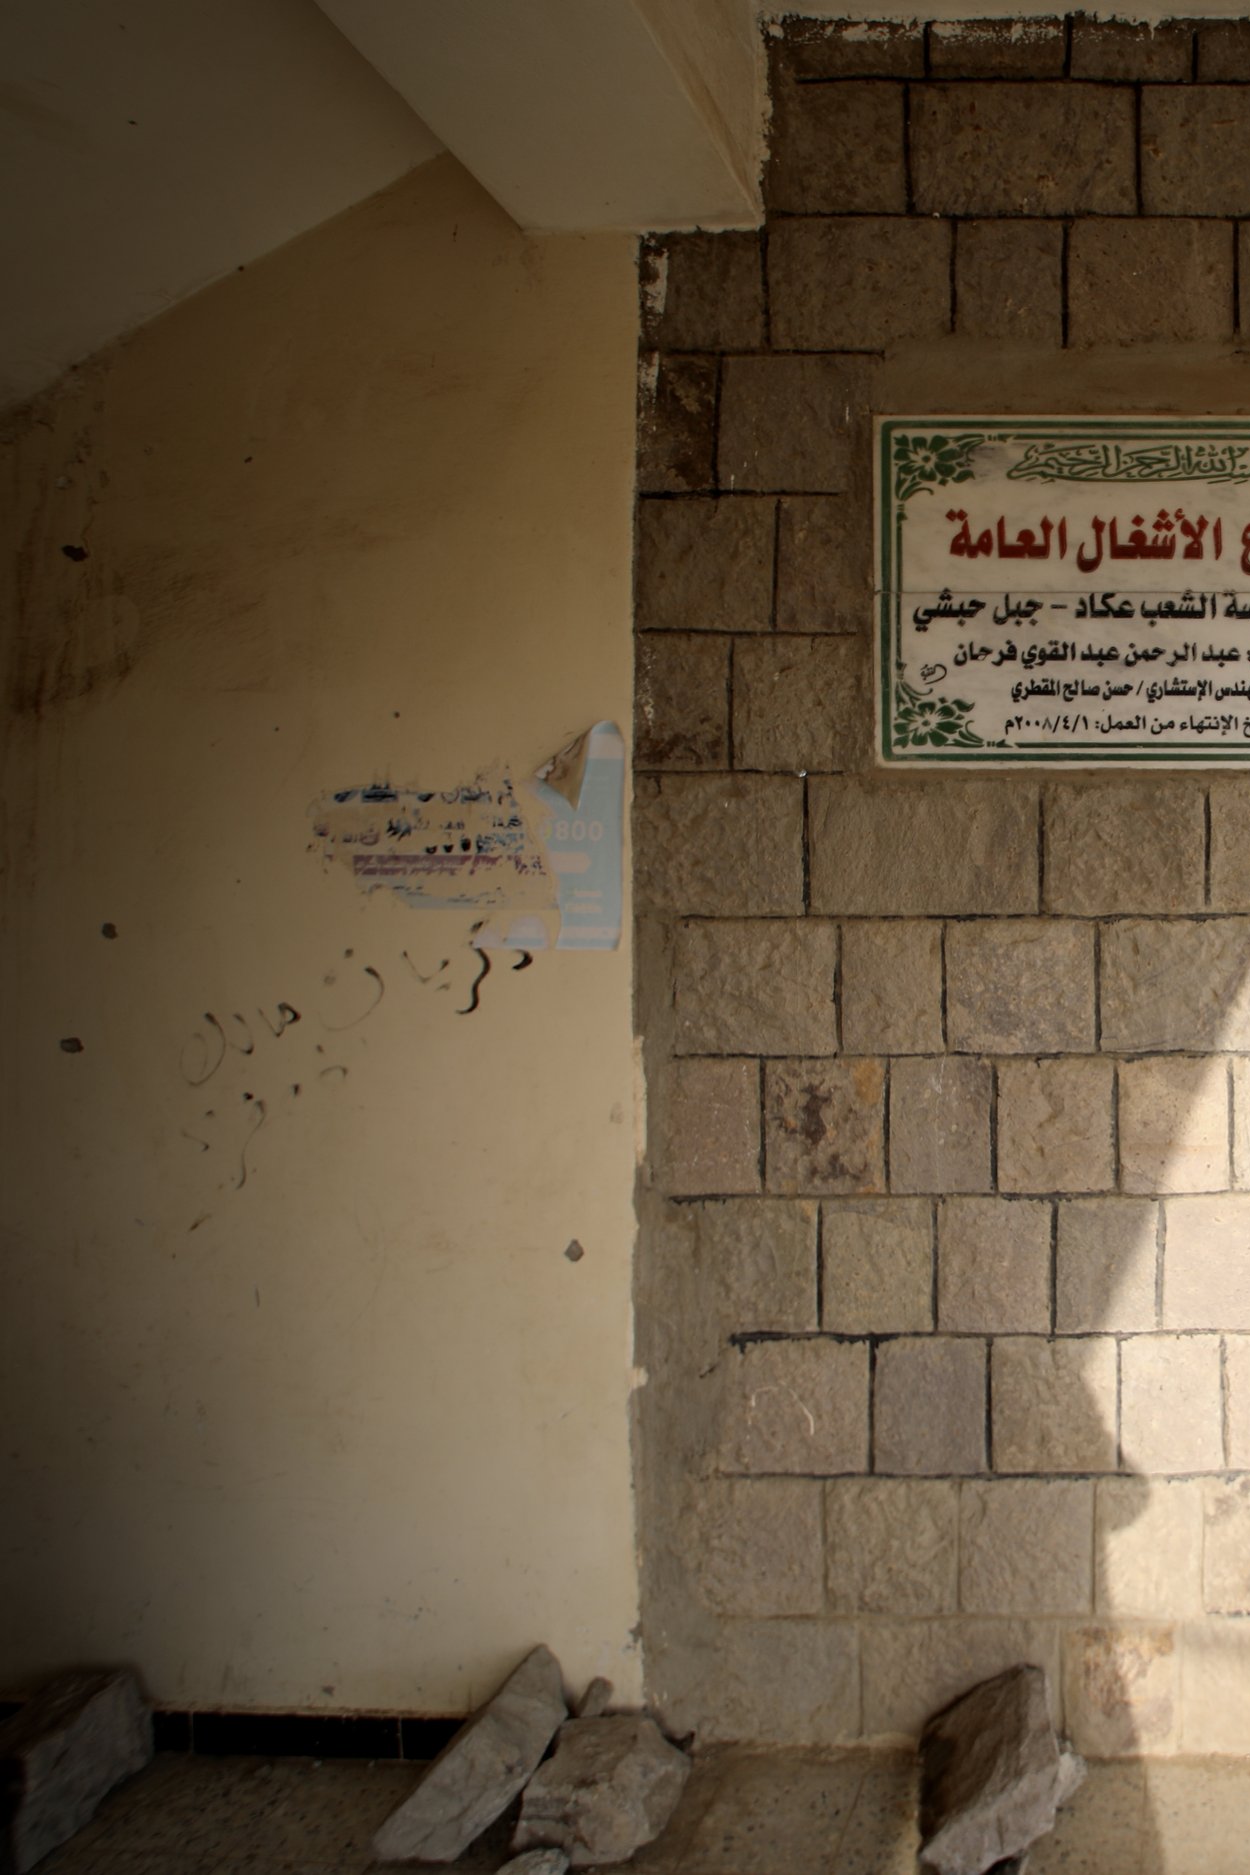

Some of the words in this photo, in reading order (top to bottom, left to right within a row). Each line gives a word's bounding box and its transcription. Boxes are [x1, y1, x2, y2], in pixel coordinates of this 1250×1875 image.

[945, 509, 1067, 560] العامة
[1076, 508, 1222, 573] الأشغال
[913, 587, 986, 632] حبشي
[993, 592, 1043, 626] جبل
[1075, 592, 1135, 619] عكاد
[1140, 588, 1216, 627] الشعب
[953, 640, 1017, 666] فرحان
[1021, 640, 1076, 669] القوي
[1081, 644, 1120, 668] عبد
[1123, 643, 1196, 668] الرحمن
[1202, 644, 1241, 668] عبد
[1011, 678, 1061, 703] المقطري
[1063, 679, 1100, 703] صالح
[1102, 680, 1134, 701] حسن
[1095, 714, 1146, 735] العمل:
[1150, 716, 1175, 736] من
